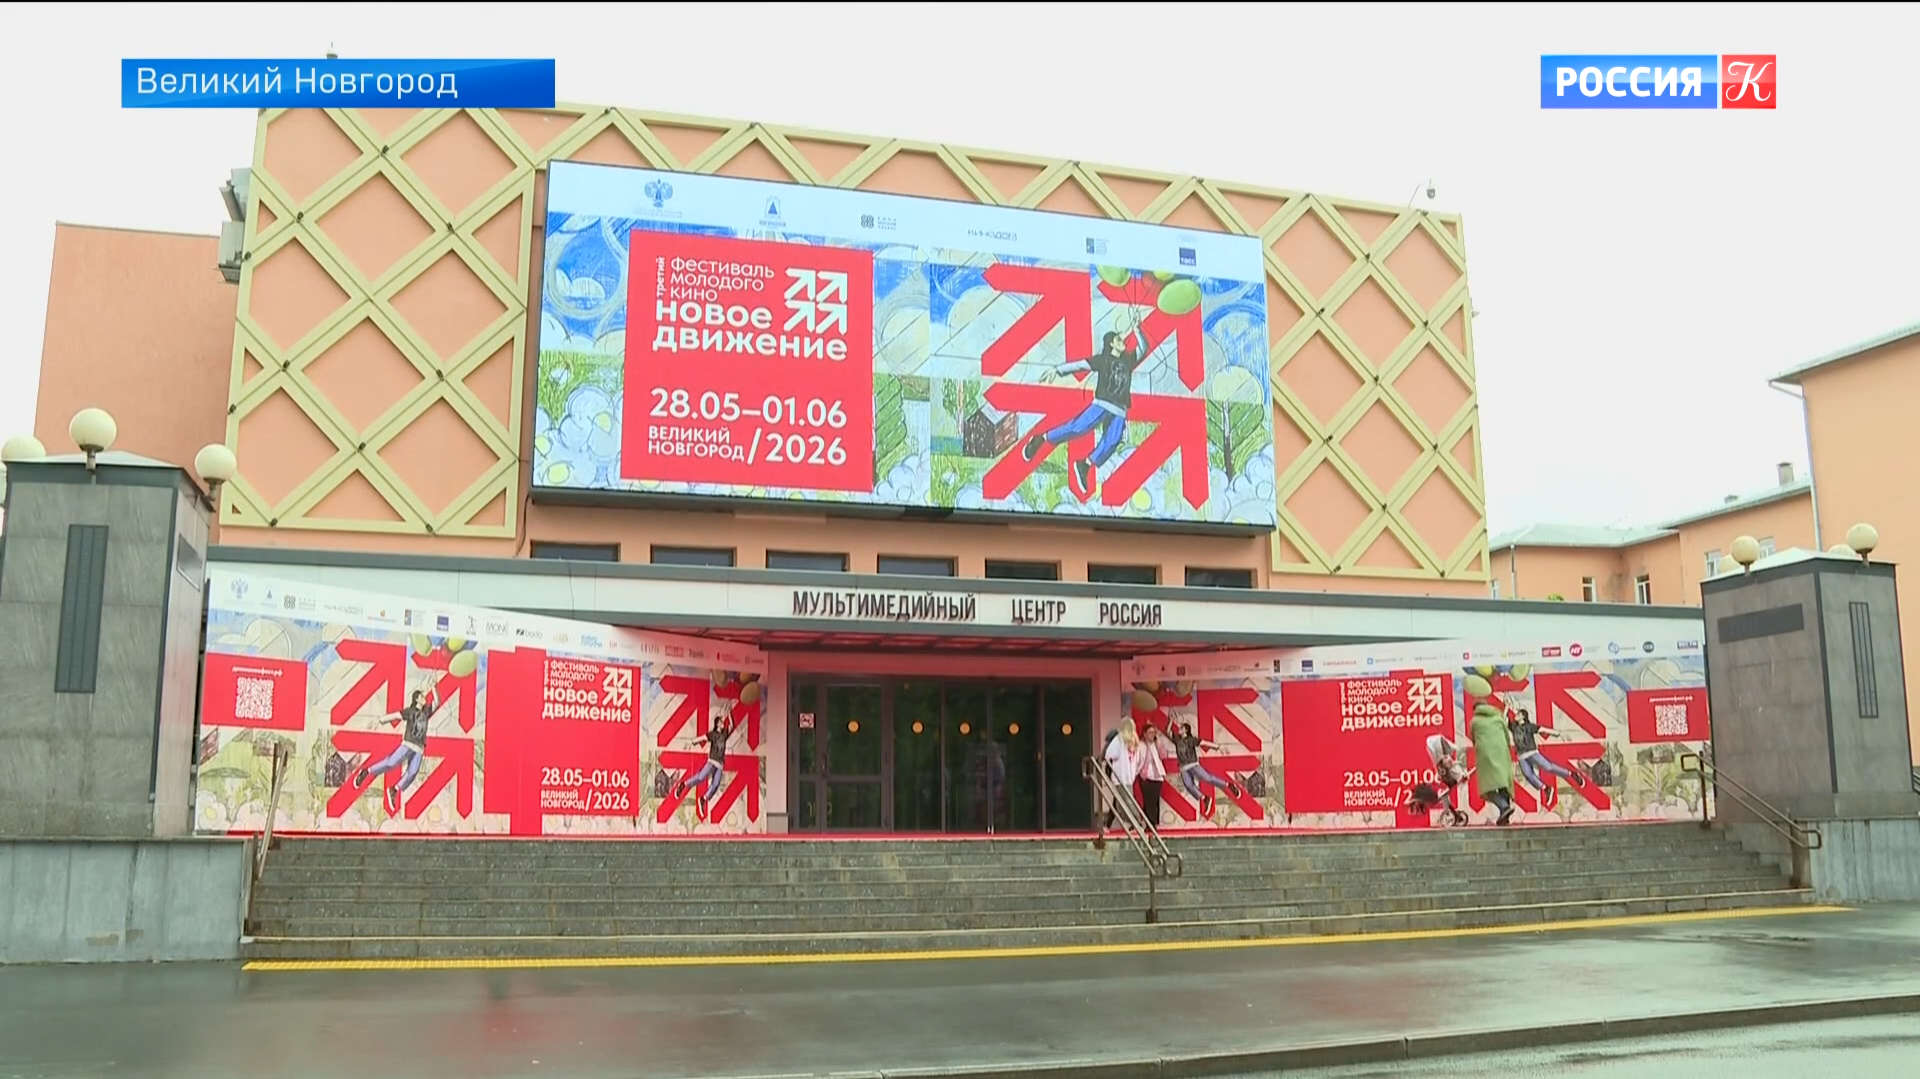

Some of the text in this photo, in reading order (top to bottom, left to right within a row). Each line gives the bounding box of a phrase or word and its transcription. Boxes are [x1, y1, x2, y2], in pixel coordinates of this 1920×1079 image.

[655, 256, 667, 298] третий
[670, 272, 765, 292] молодого
[670, 286, 718, 302] кино
[656, 299, 773, 329] новое
[652, 325, 848, 361] движение
[648, 425, 730, 443] ВЕЛИКИЙ
[648, 441, 745, 462] НОВГОРОД
[792, 590, 1163, 626] МУЛЬТИМЕДИЙНЫЙ ЦЕНТР РОССИЯ
[541, 788, 579, 800] ВЕЛИКИЙ
[1344, 788, 1386, 799] ВЕЛИКИЙ
[1344, 797, 1394, 807] НОВГОРОД
[540, 799, 585, 811] НОВГОРОД
